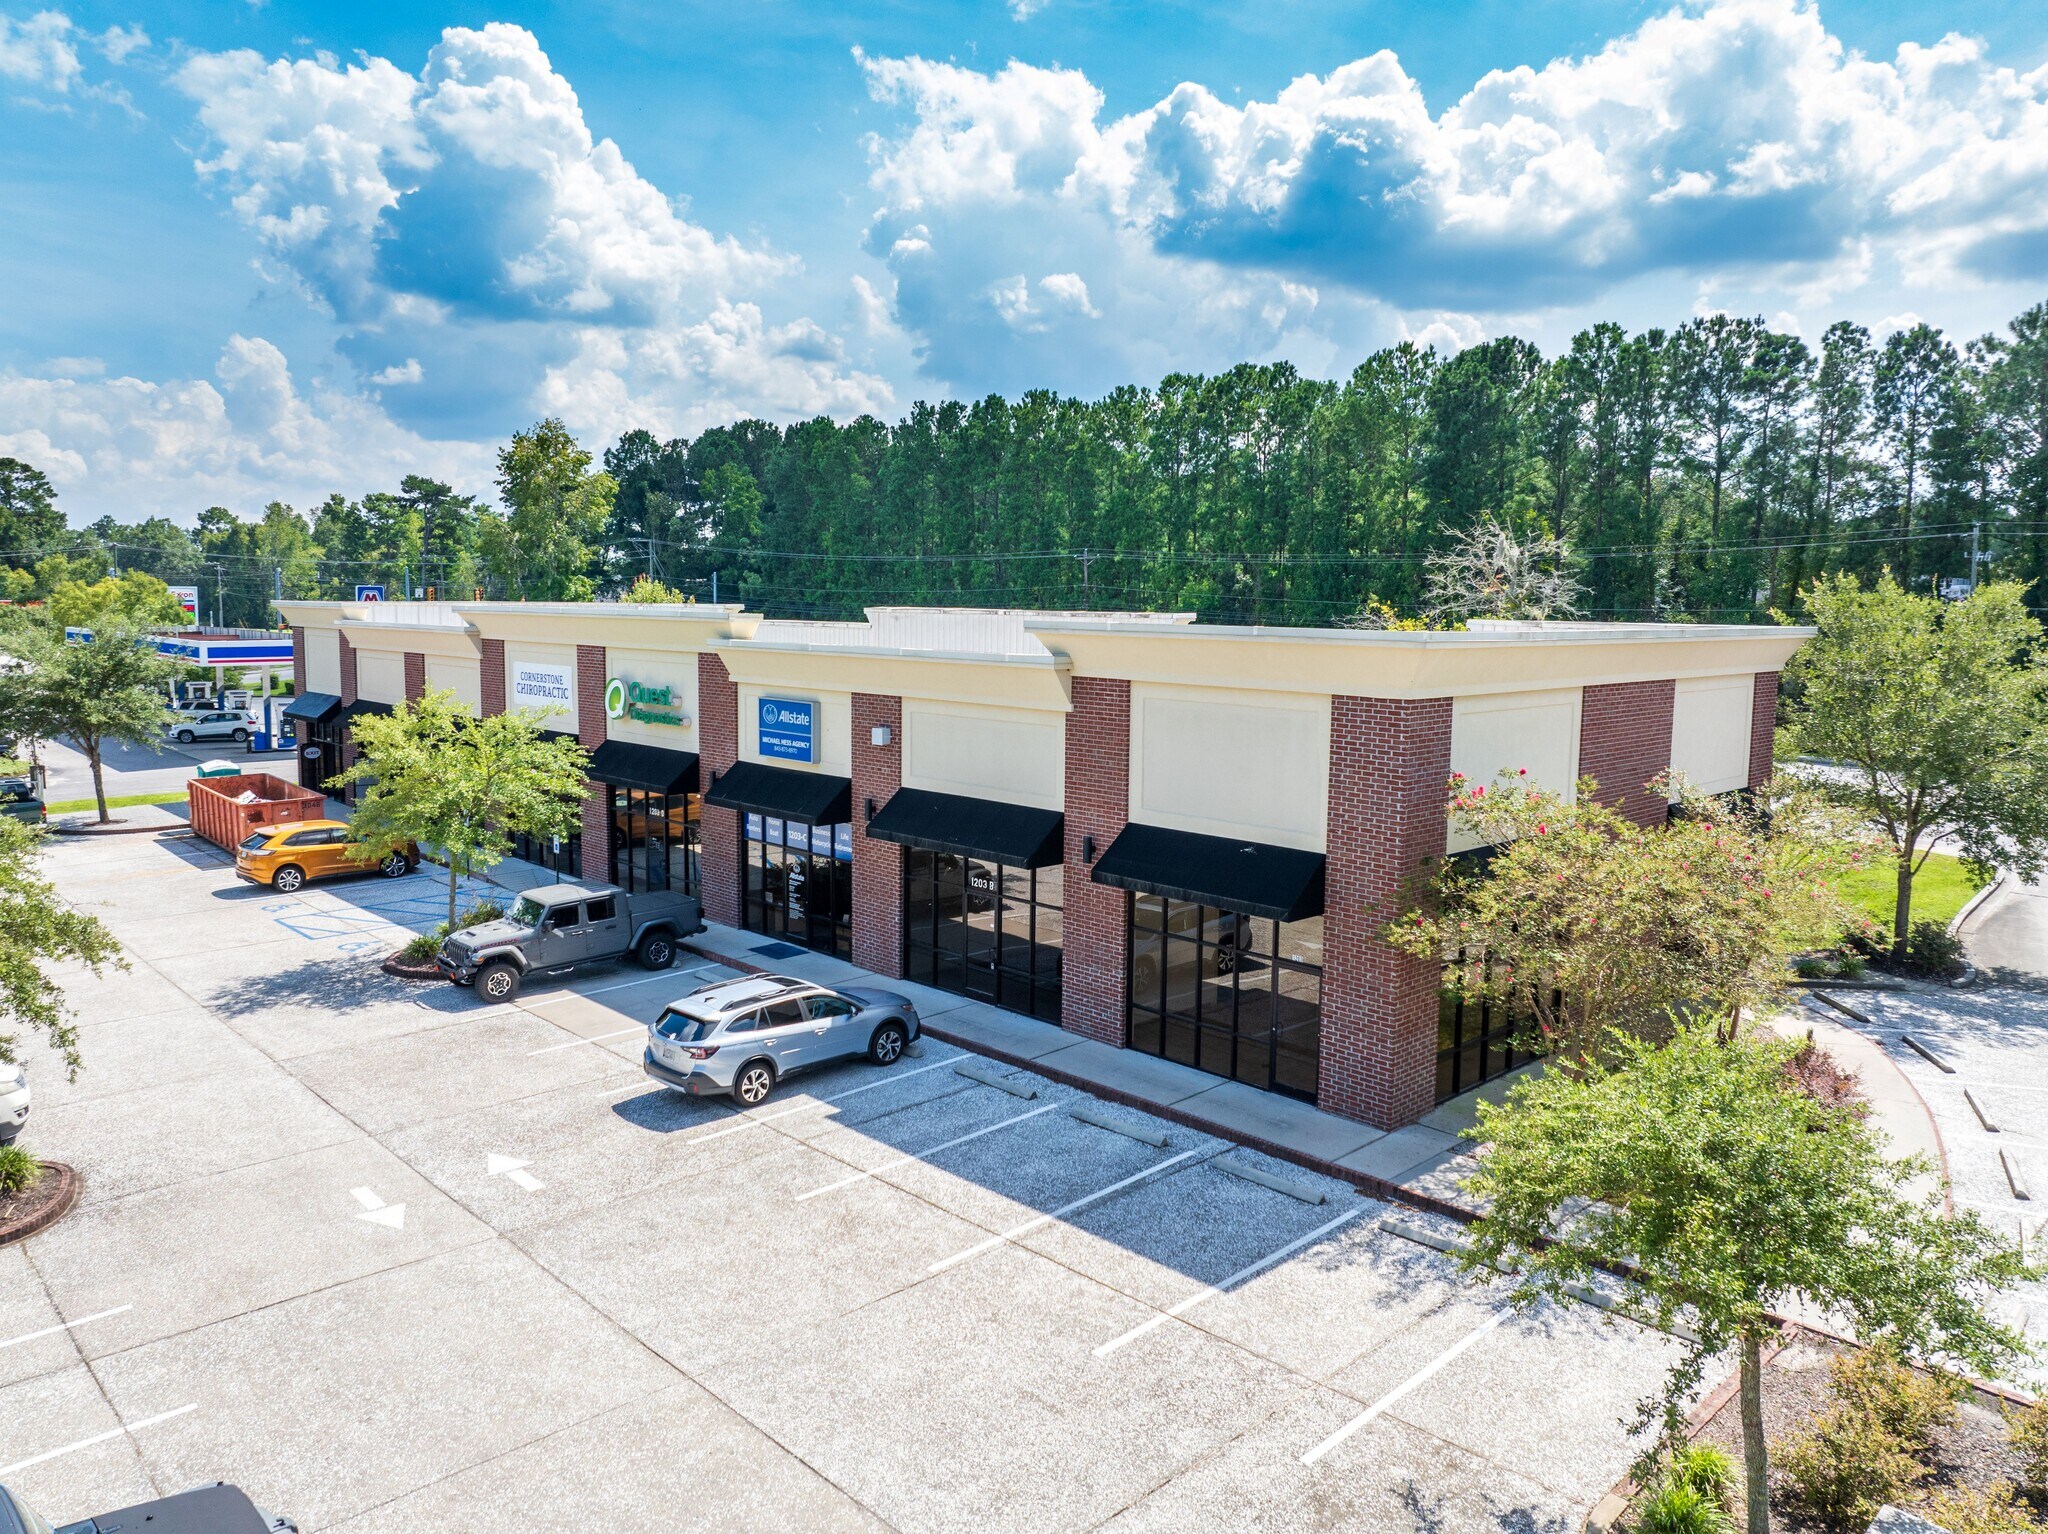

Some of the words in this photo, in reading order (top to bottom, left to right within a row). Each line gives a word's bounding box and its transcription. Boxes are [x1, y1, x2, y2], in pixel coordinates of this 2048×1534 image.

[520, 671, 564, 685] CORNERSTONE
[516, 682, 569, 699] CHIROPRACTIC
[629, 681, 672, 706] Quest
[778, 710, 810, 725] Allstate
[762, 736, 781, 745] MICHAEL
[781, 739, 792, 747] HESS
[792, 740, 810, 748] AGENCY
[788, 830, 807, 842] 1203-C
[840, 832, 849, 841] Life
[971, 877, 987, 888] 1203
[989, 880, 994, 890] B
